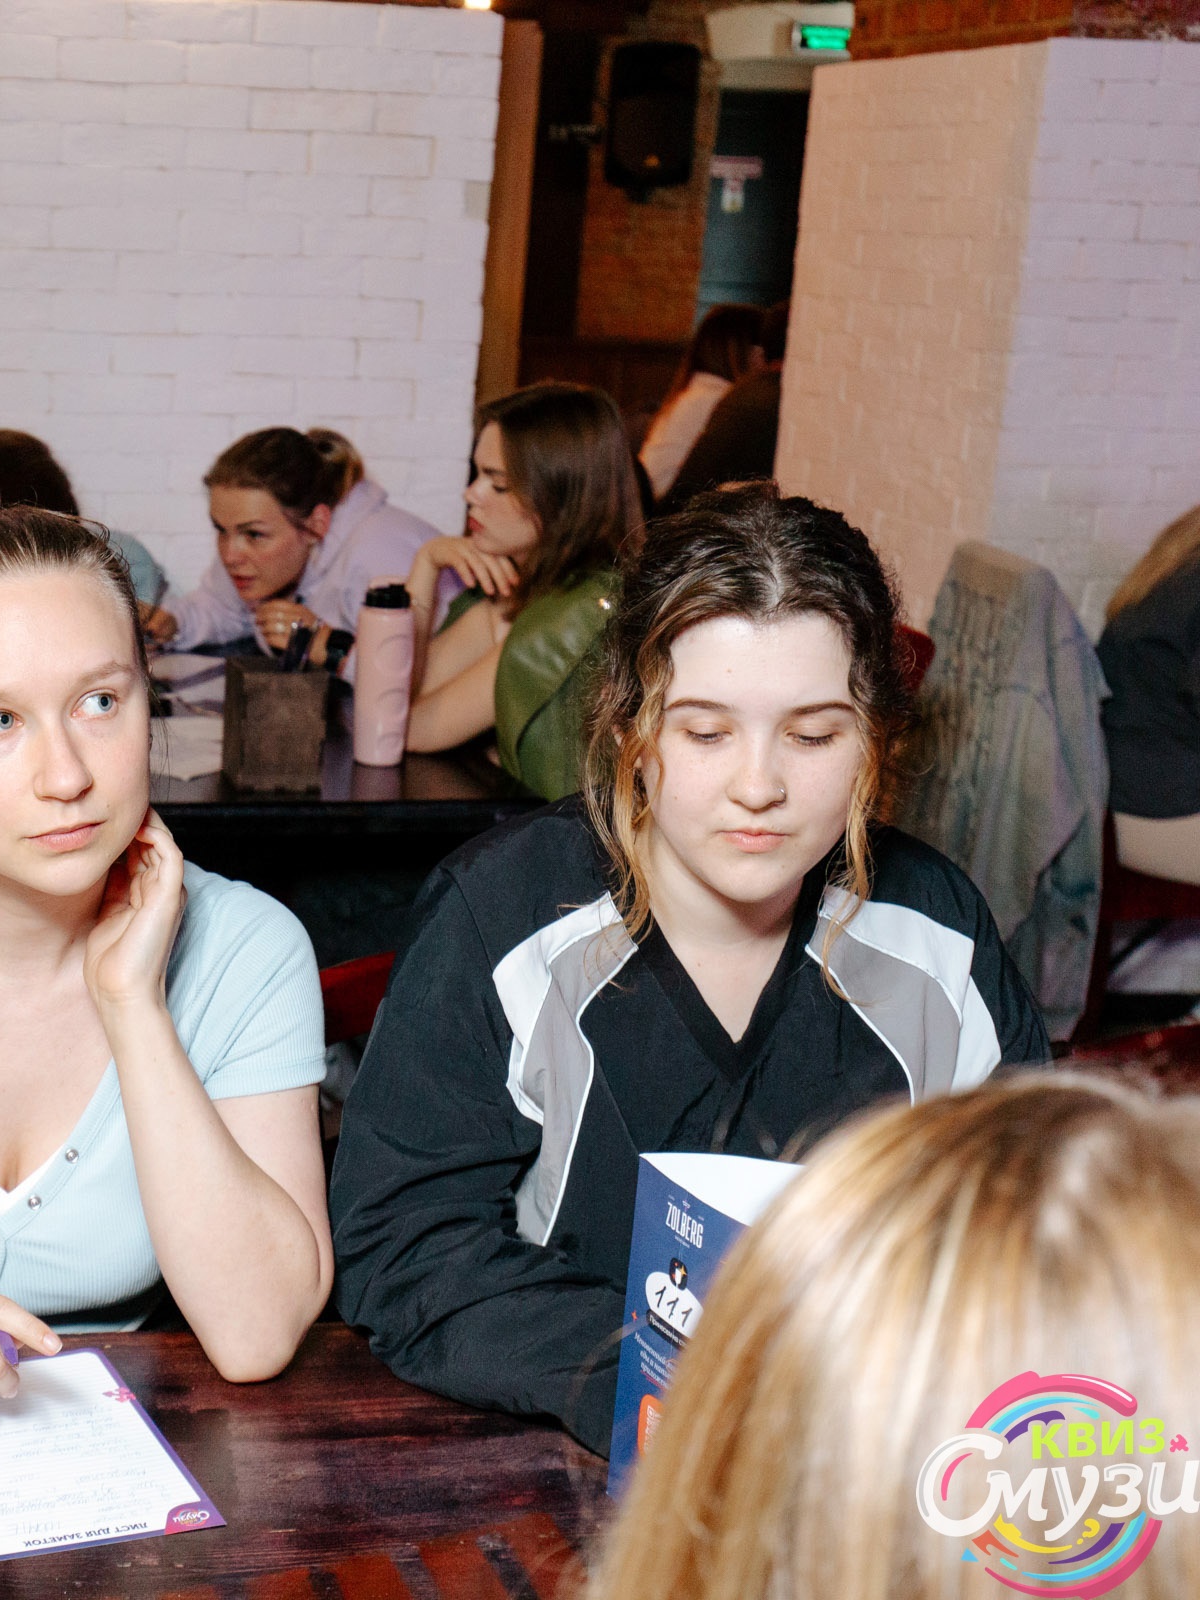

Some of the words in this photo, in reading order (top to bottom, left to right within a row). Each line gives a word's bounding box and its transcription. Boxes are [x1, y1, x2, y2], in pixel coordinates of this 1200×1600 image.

[665, 1201, 704, 1249] ZOLBERG
[85, 1527, 111, 1539] ДЛЯ
[115, 1522, 149, 1534] ЛИСТ
[23, 1532, 83, 1548] ЗАМЕТОК
